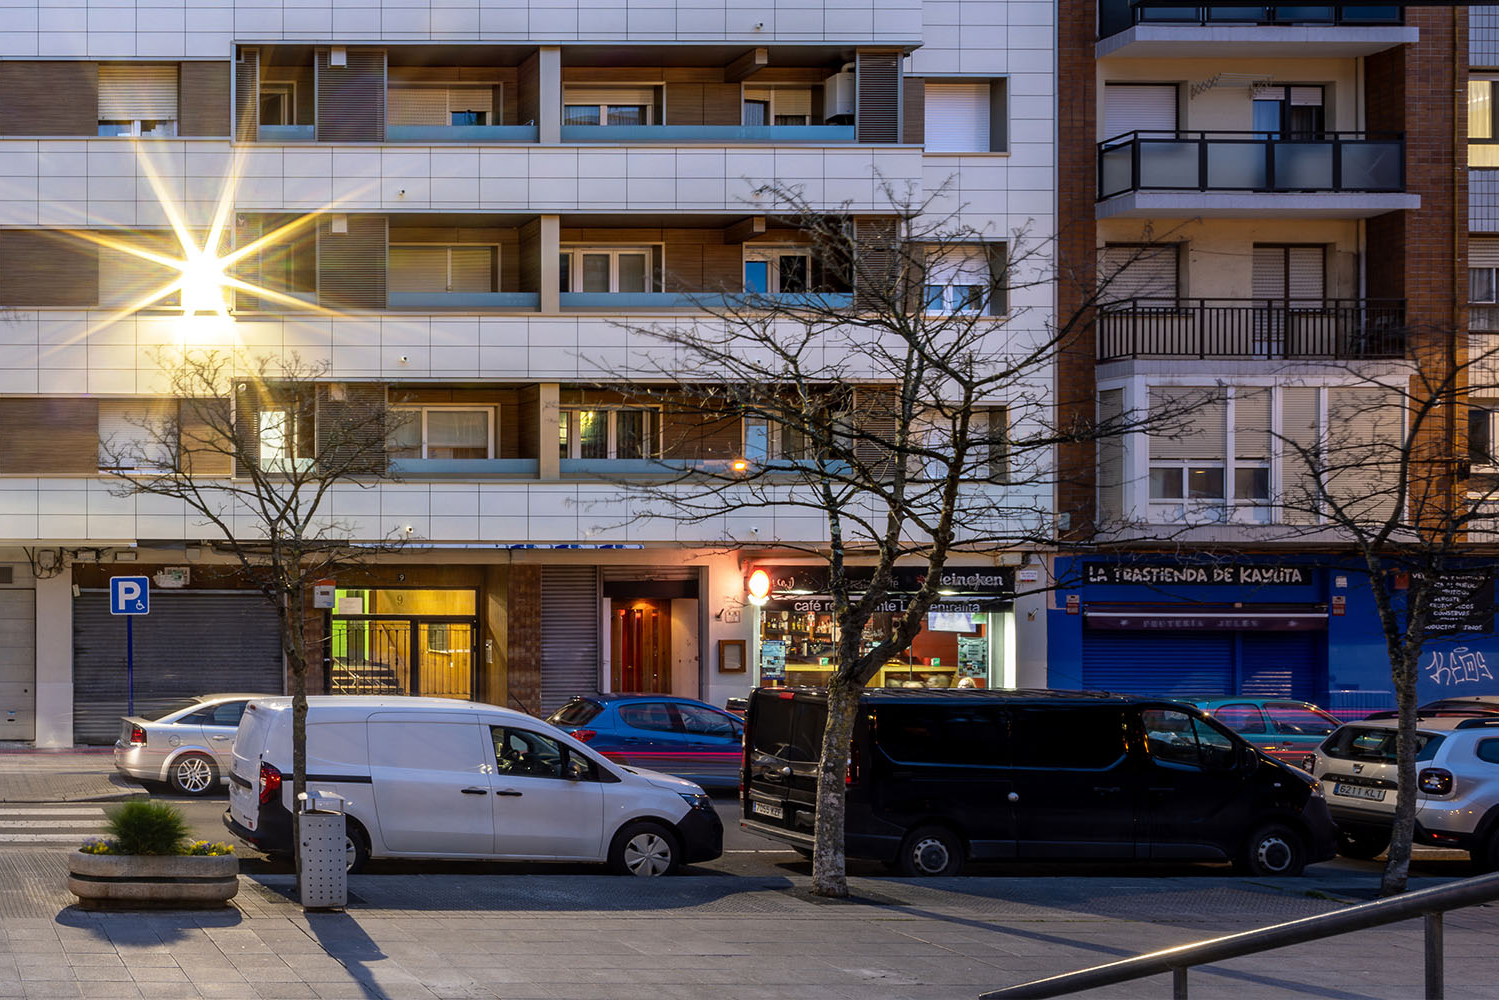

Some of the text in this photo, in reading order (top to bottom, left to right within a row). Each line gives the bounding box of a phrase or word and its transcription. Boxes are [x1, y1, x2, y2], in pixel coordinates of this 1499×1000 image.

[939, 573, 1004, 587] eineken
[1089, 566, 1302, 584] LA TRASTIENDA DE KAYLITA
[117, 581, 141, 610] P
[397, 594, 404, 605] 9
[794, 600, 822, 612] café
[928, 602, 981, 613] entralita
[1339, 785, 1383, 798] 6211 KLT
